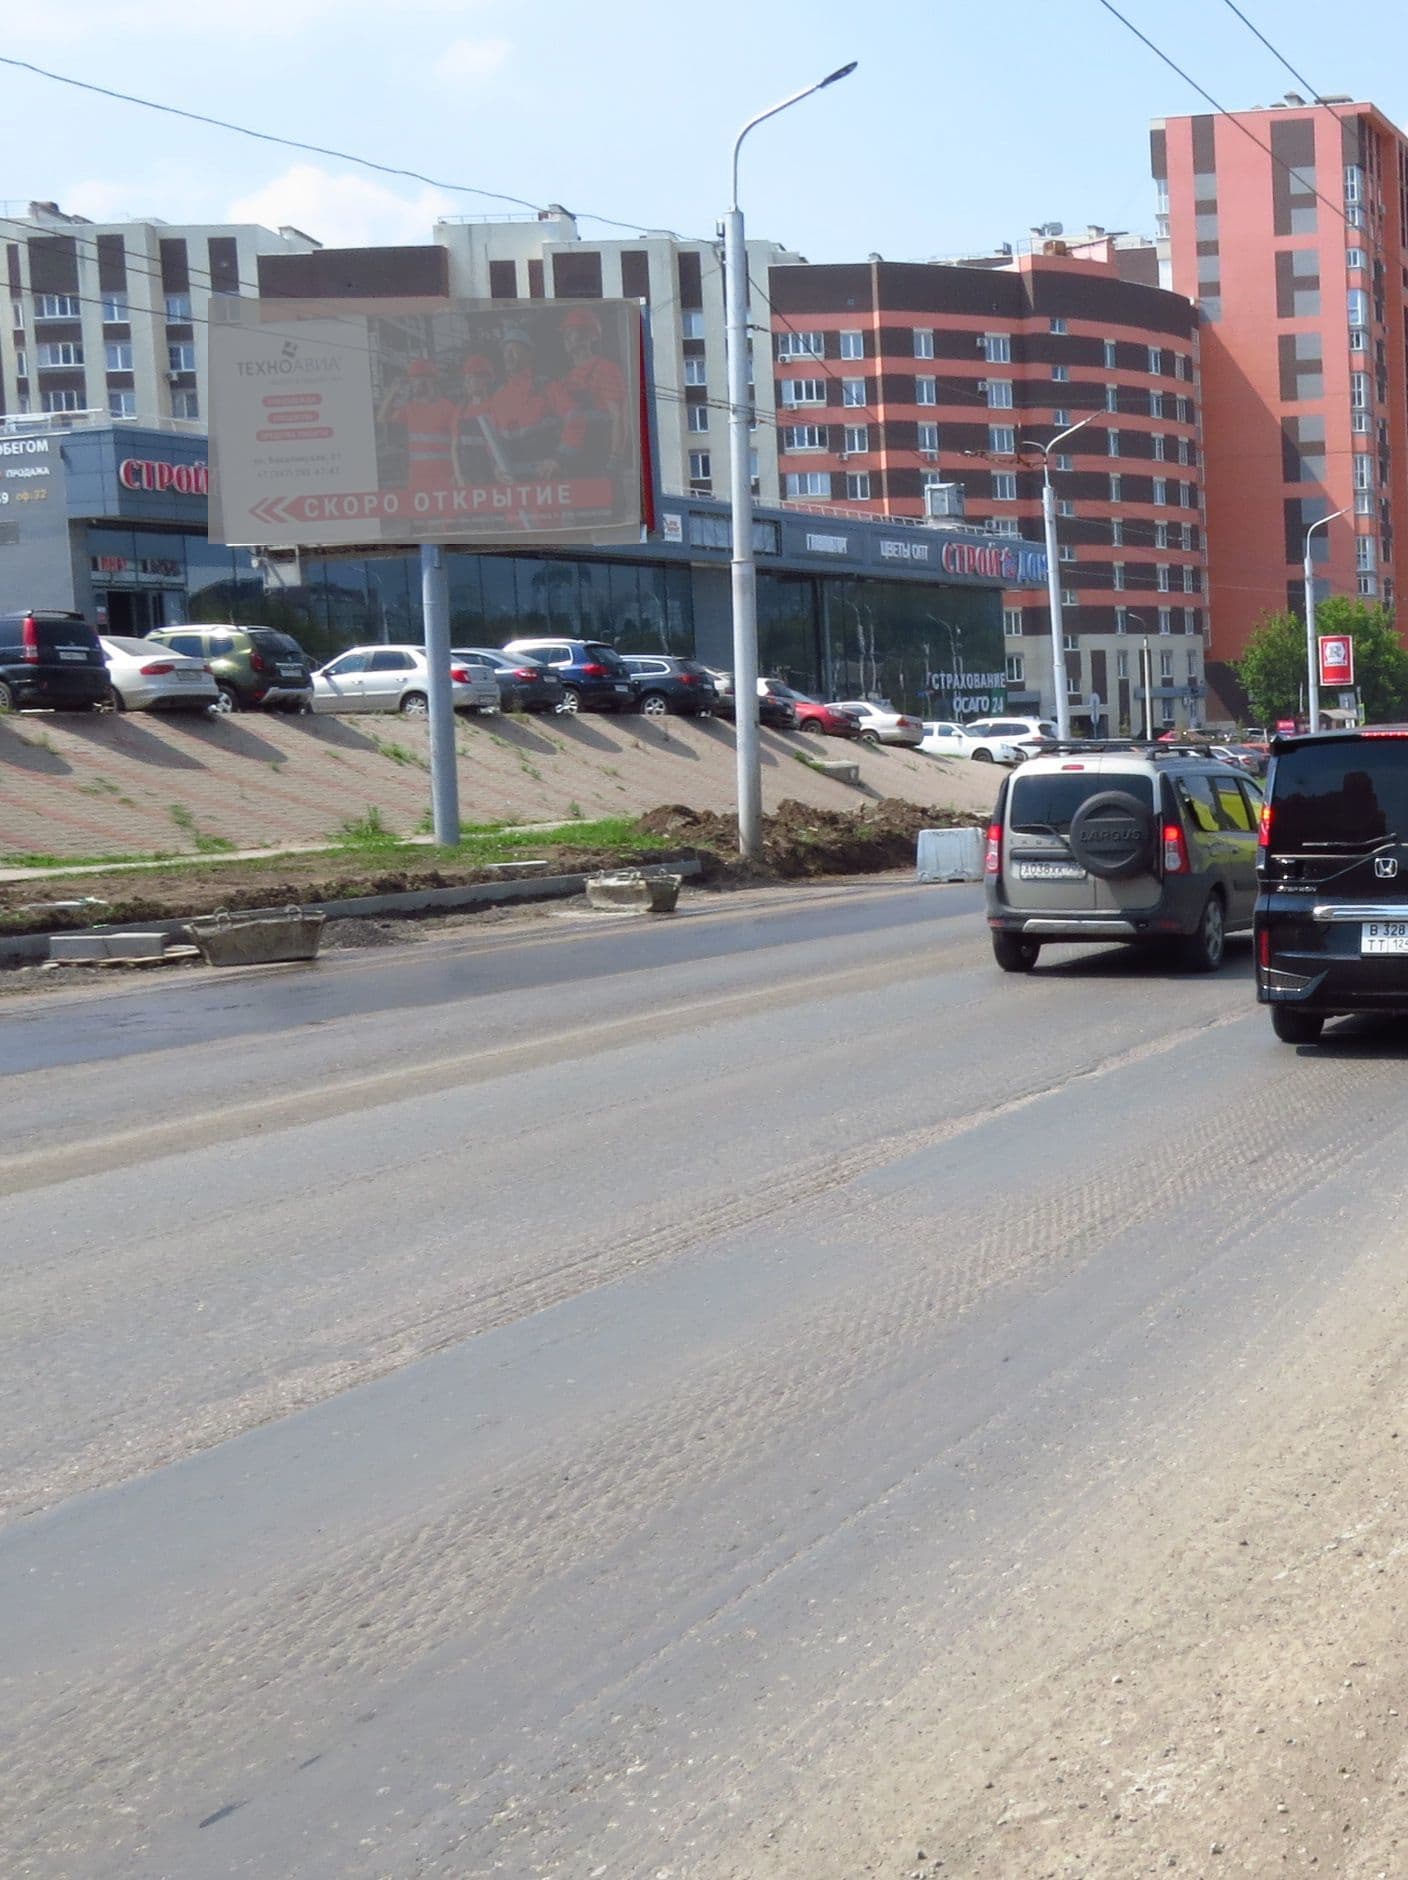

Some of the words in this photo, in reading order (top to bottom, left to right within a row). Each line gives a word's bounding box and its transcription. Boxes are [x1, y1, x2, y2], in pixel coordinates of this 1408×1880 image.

[235, 356, 341, 377] ТЕХНОАВИА
[0, 439, 49, 456] БЕГОМ
[5, 466, 50, 479] ПРОДАЖА
[304, 494, 400, 519] СКОРО
[414, 484, 573, 512] ОТКРЫТИЕ
[880, 540, 911, 560] ЦВЕТЫ
[942, 542, 1001, 577] СТРОЙ
[931, 672, 1006, 689] СТРАХОВАНИЕ
[953, 696, 990, 713] ОСАГО
[991, 697, 1004, 713] 24
[1080, 828, 1143, 842] LARGUS
[1383, 924, 1406, 936] 328
